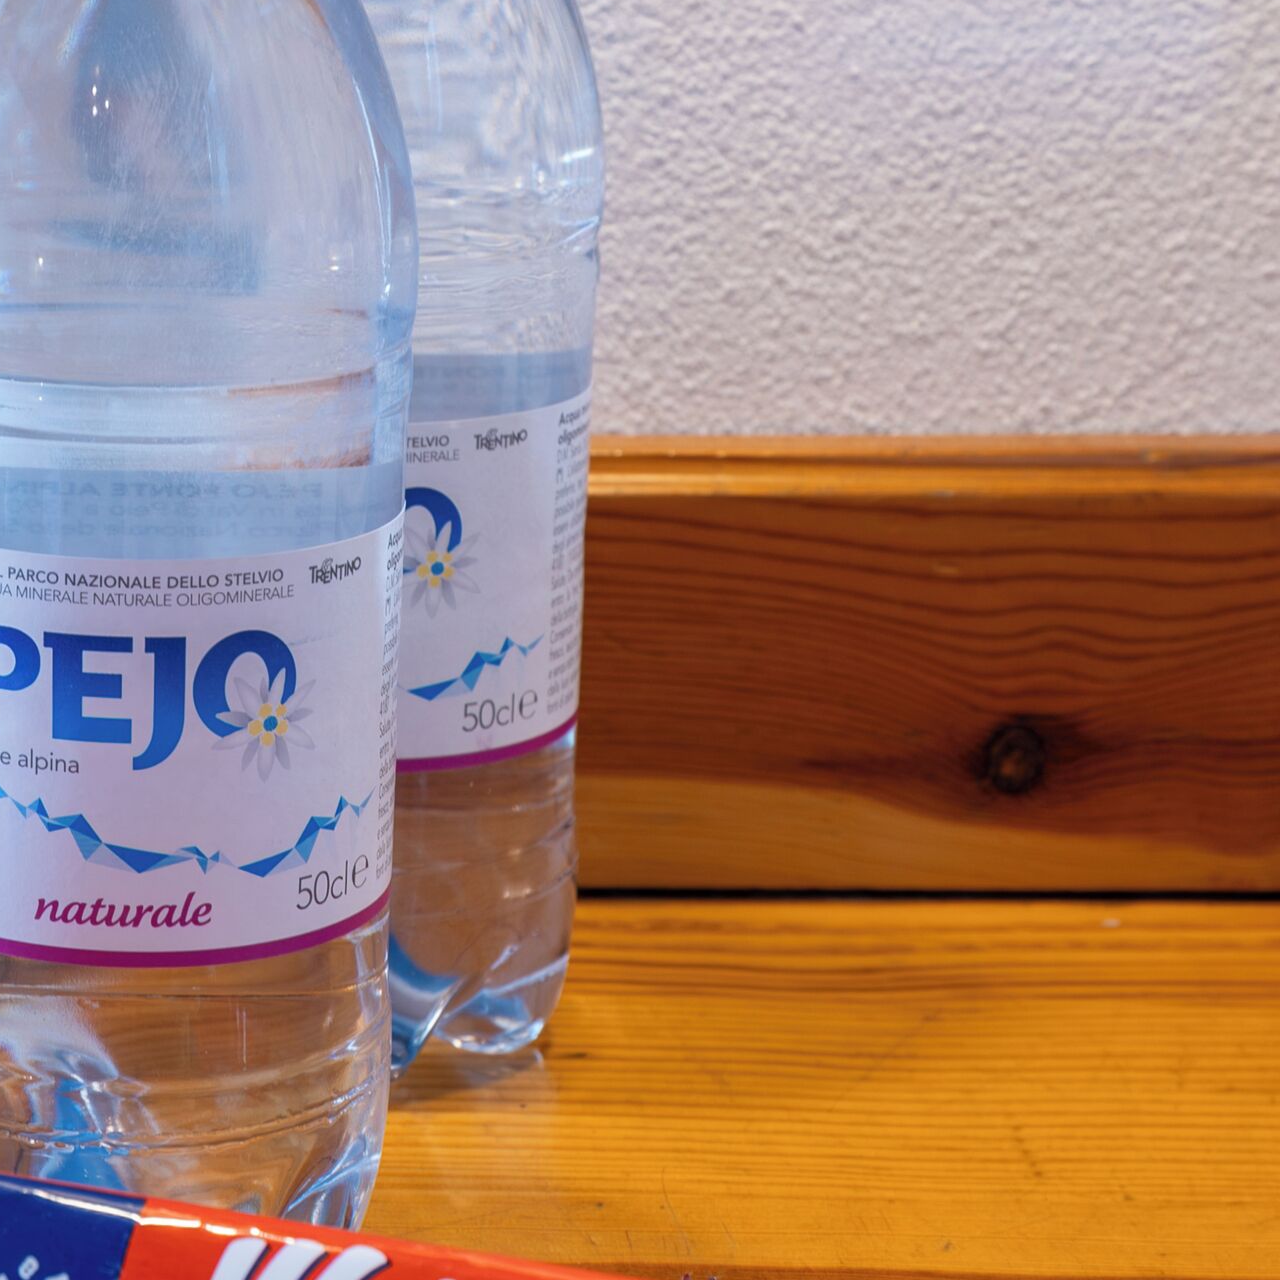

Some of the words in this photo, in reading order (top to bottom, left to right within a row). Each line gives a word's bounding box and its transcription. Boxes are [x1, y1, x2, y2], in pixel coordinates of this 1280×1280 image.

[406, 435, 449, 449] TELVIO
[8, 567, 59, 585] PARCO
[64, 573, 161, 589] NAZIONALE
[167, 574, 219, 589] DELLO
[224, 569, 284, 587] STELVIO
[309, 557, 361, 584] TRENTINO
[16, 585, 88, 605] MINERALE
[93, 592, 171, 607] NATURALE
[176, 584, 295, 607] OLIGOMINERALE
[17, 747, 80, 776] alpina
[34, 892, 213, 929] naturale
